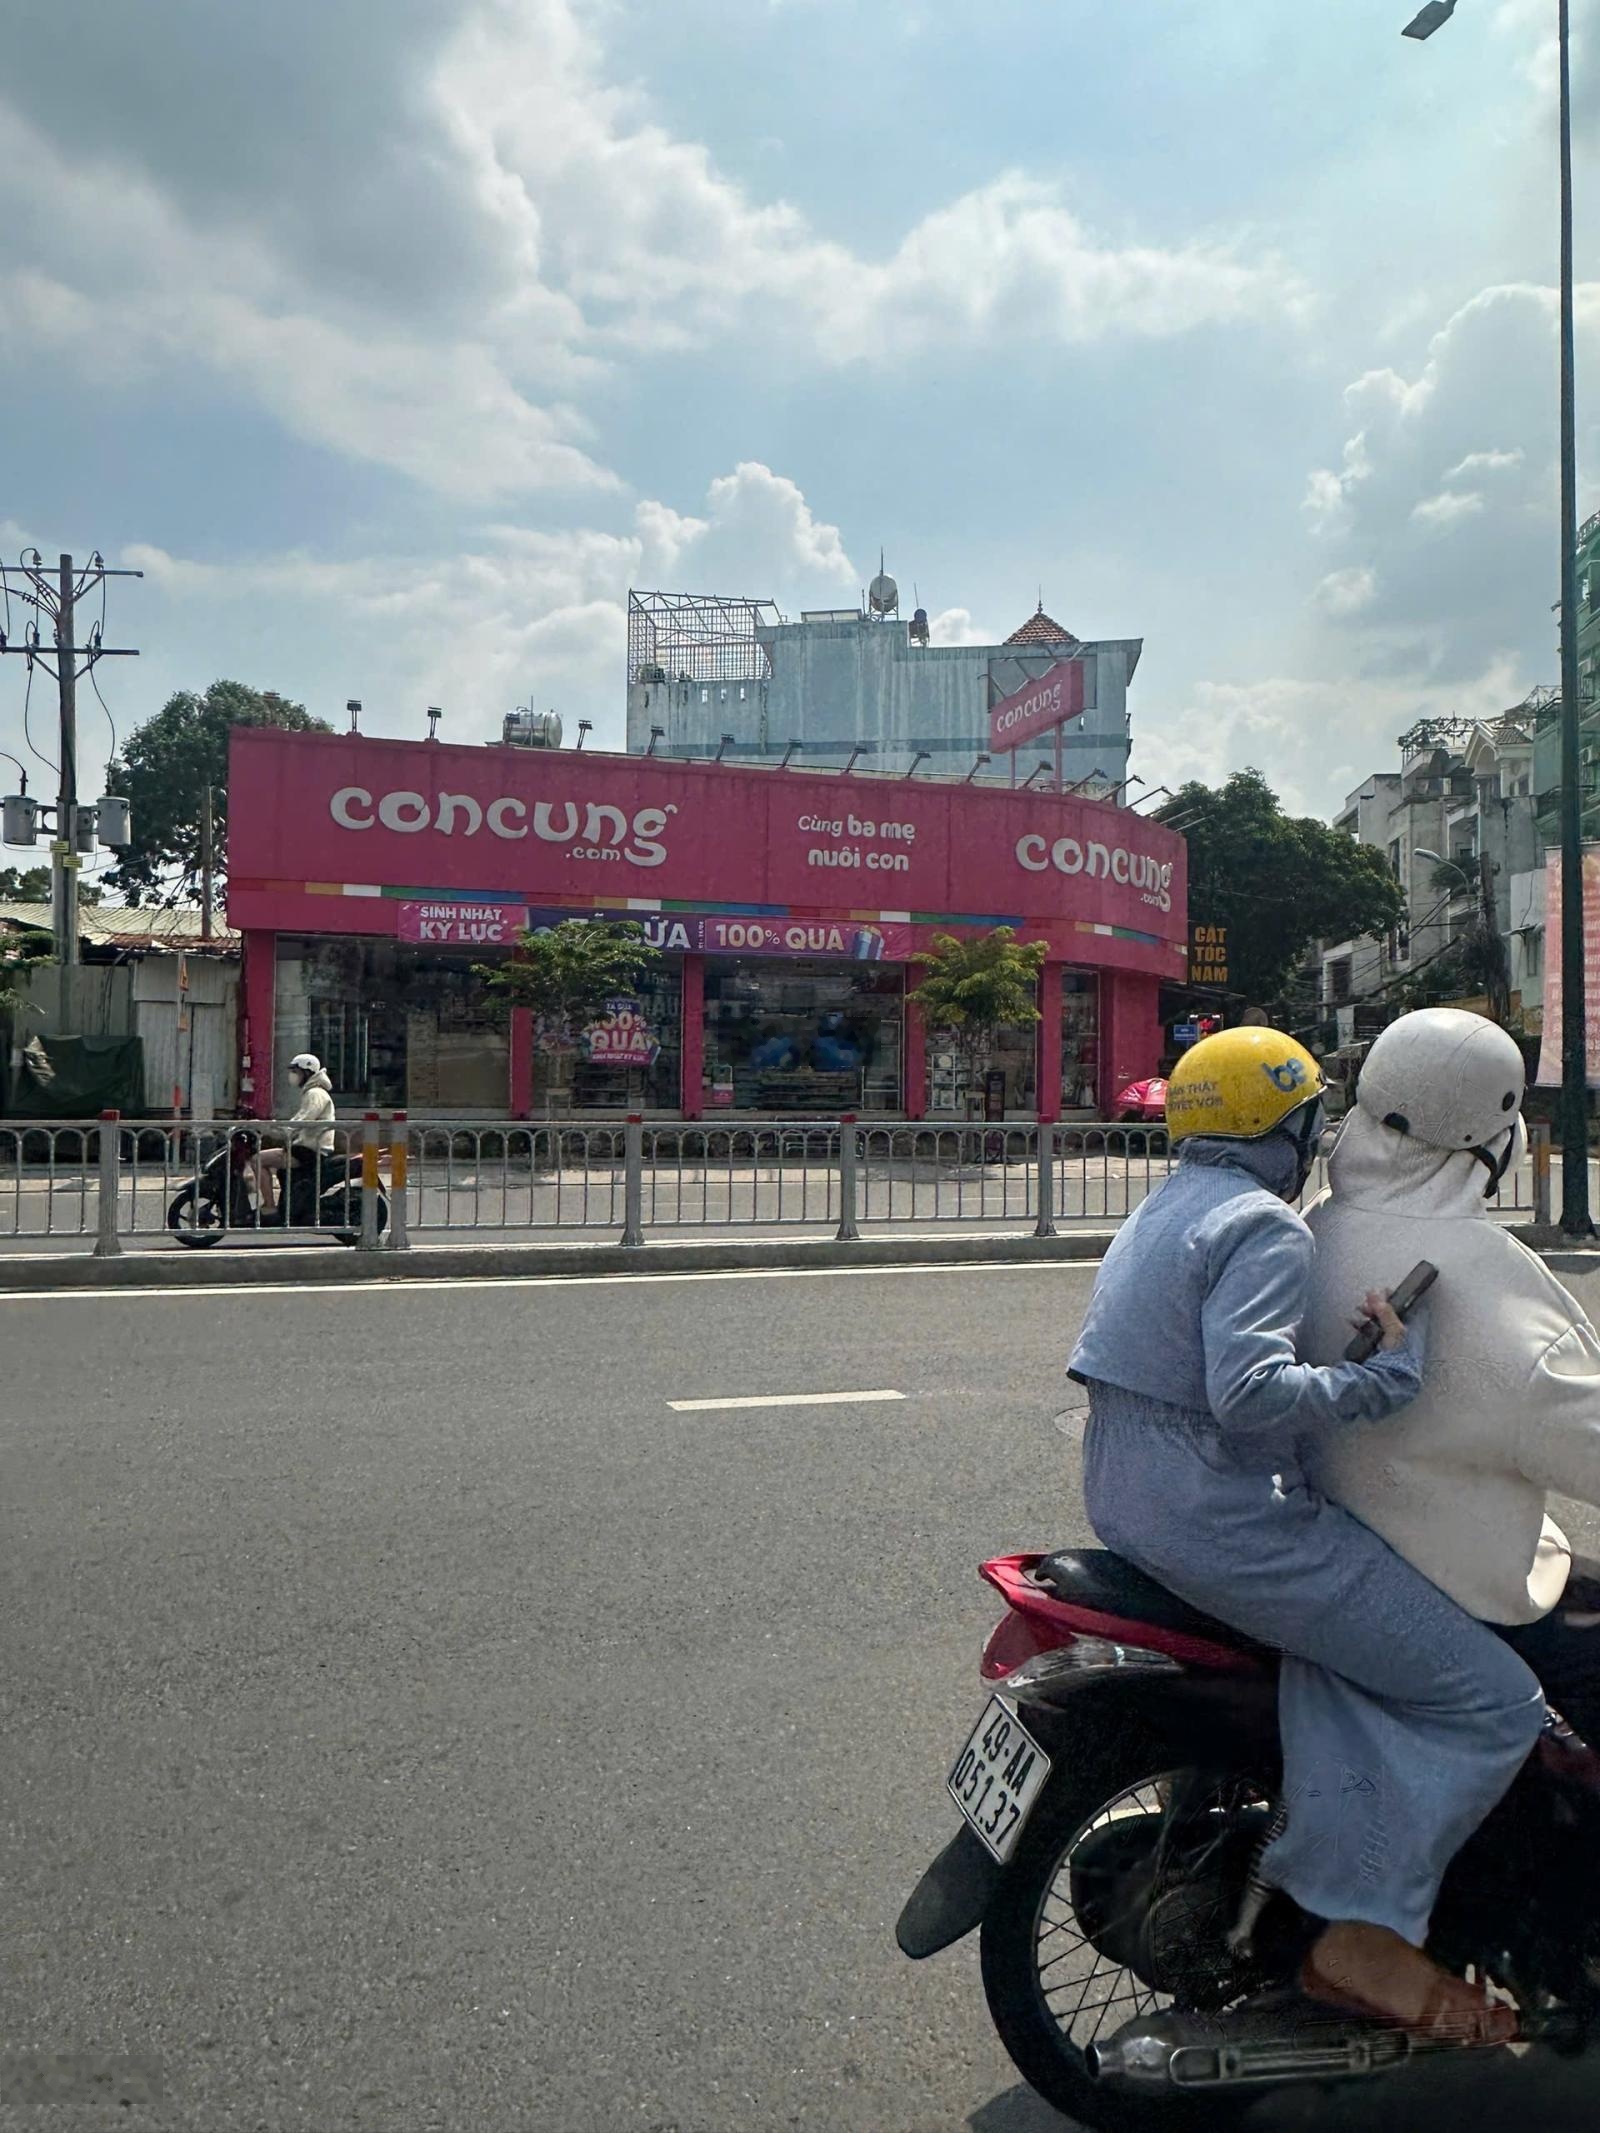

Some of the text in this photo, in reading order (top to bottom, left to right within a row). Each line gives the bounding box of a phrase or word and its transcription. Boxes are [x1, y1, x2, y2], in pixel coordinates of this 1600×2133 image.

[996, 680, 1063, 733] concung
[330, 787, 678, 867] concung
[798, 814, 915, 845] Cùng ba mẹ
[565, 846, 621, 861] .com
[808, 846, 909, 871] nuôi con
[1015, 834, 1173, 912] concung
[420, 906, 457, 919] SINH
[716, 923, 780, 947] 100%
[1191, 965, 1228, 982] NAM
[955, 1749, 1020, 1845] 051.37
